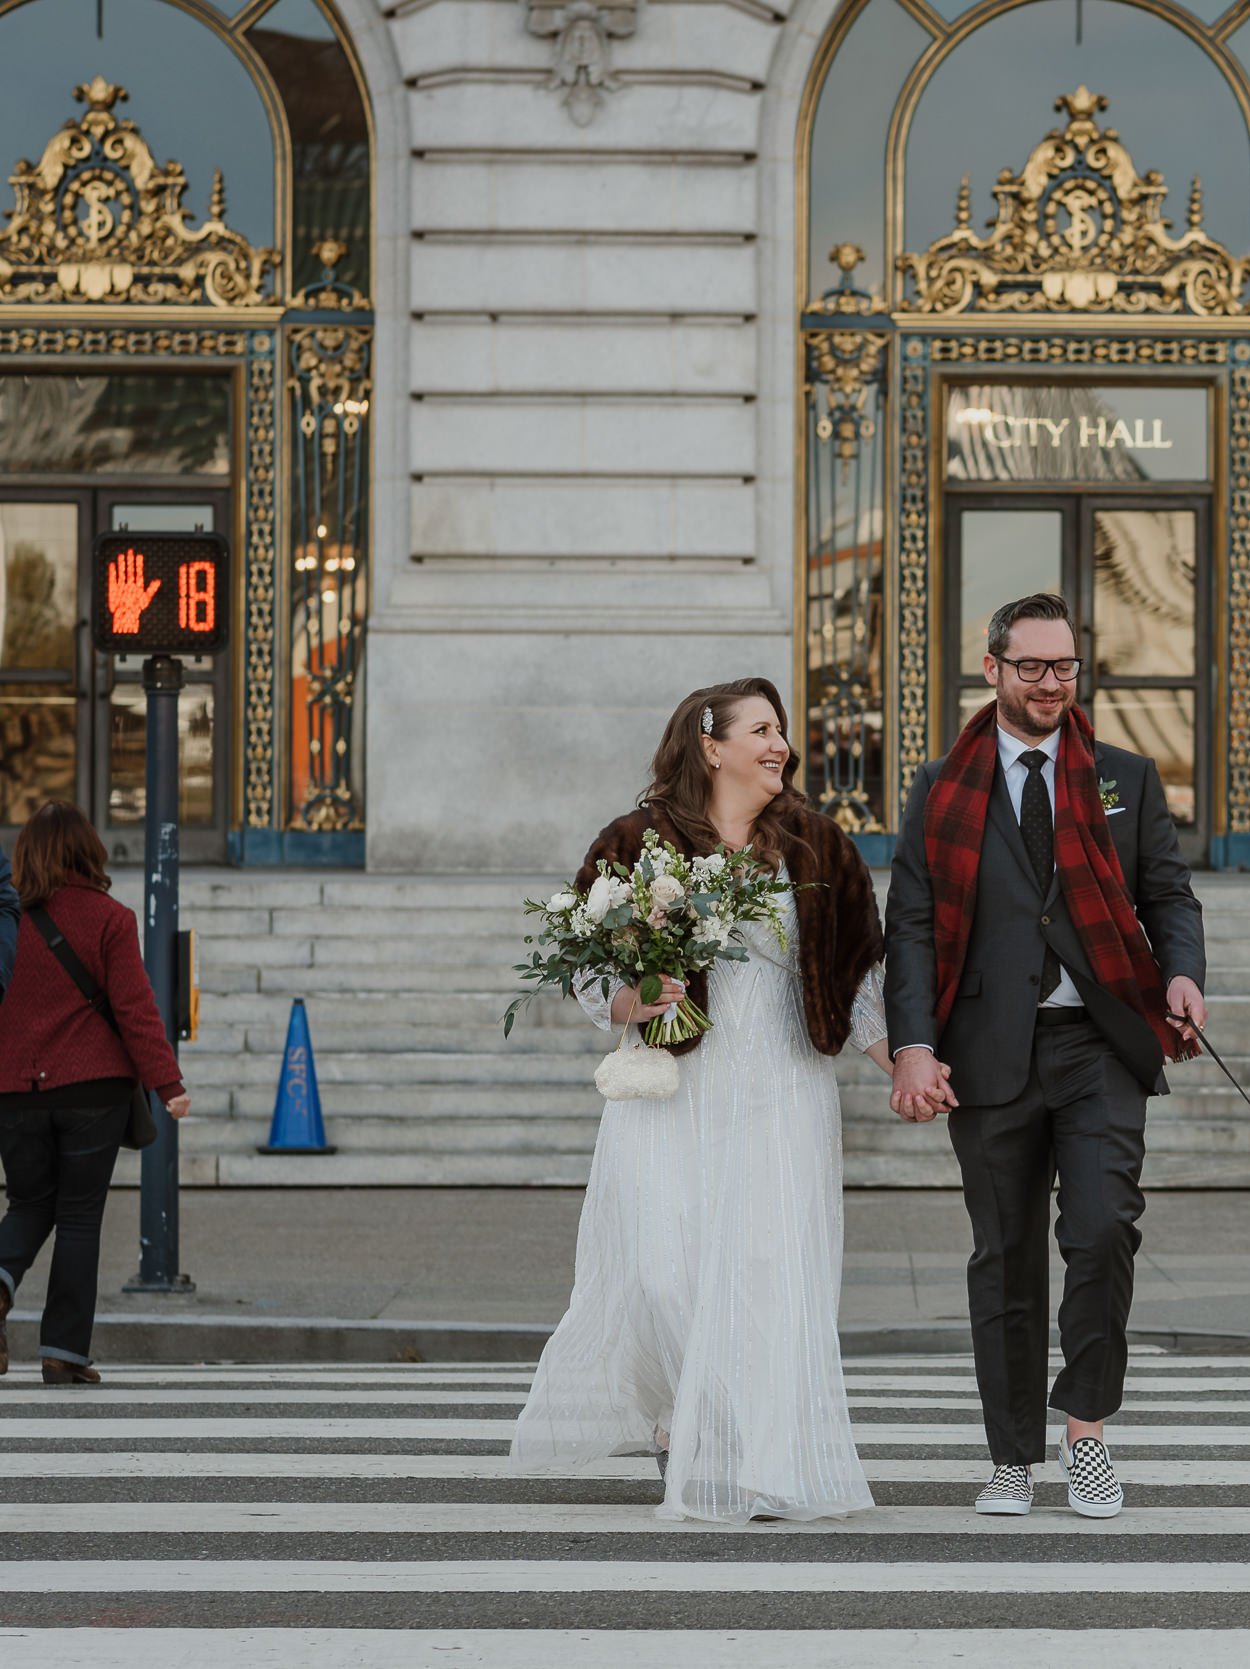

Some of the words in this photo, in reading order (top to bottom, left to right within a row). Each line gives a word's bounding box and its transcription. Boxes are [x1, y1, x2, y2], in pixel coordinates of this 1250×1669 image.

[984, 415, 1070, 447] CITY
[1079, 416, 1173, 449] HALL
[178, 560, 216, 633] 18
